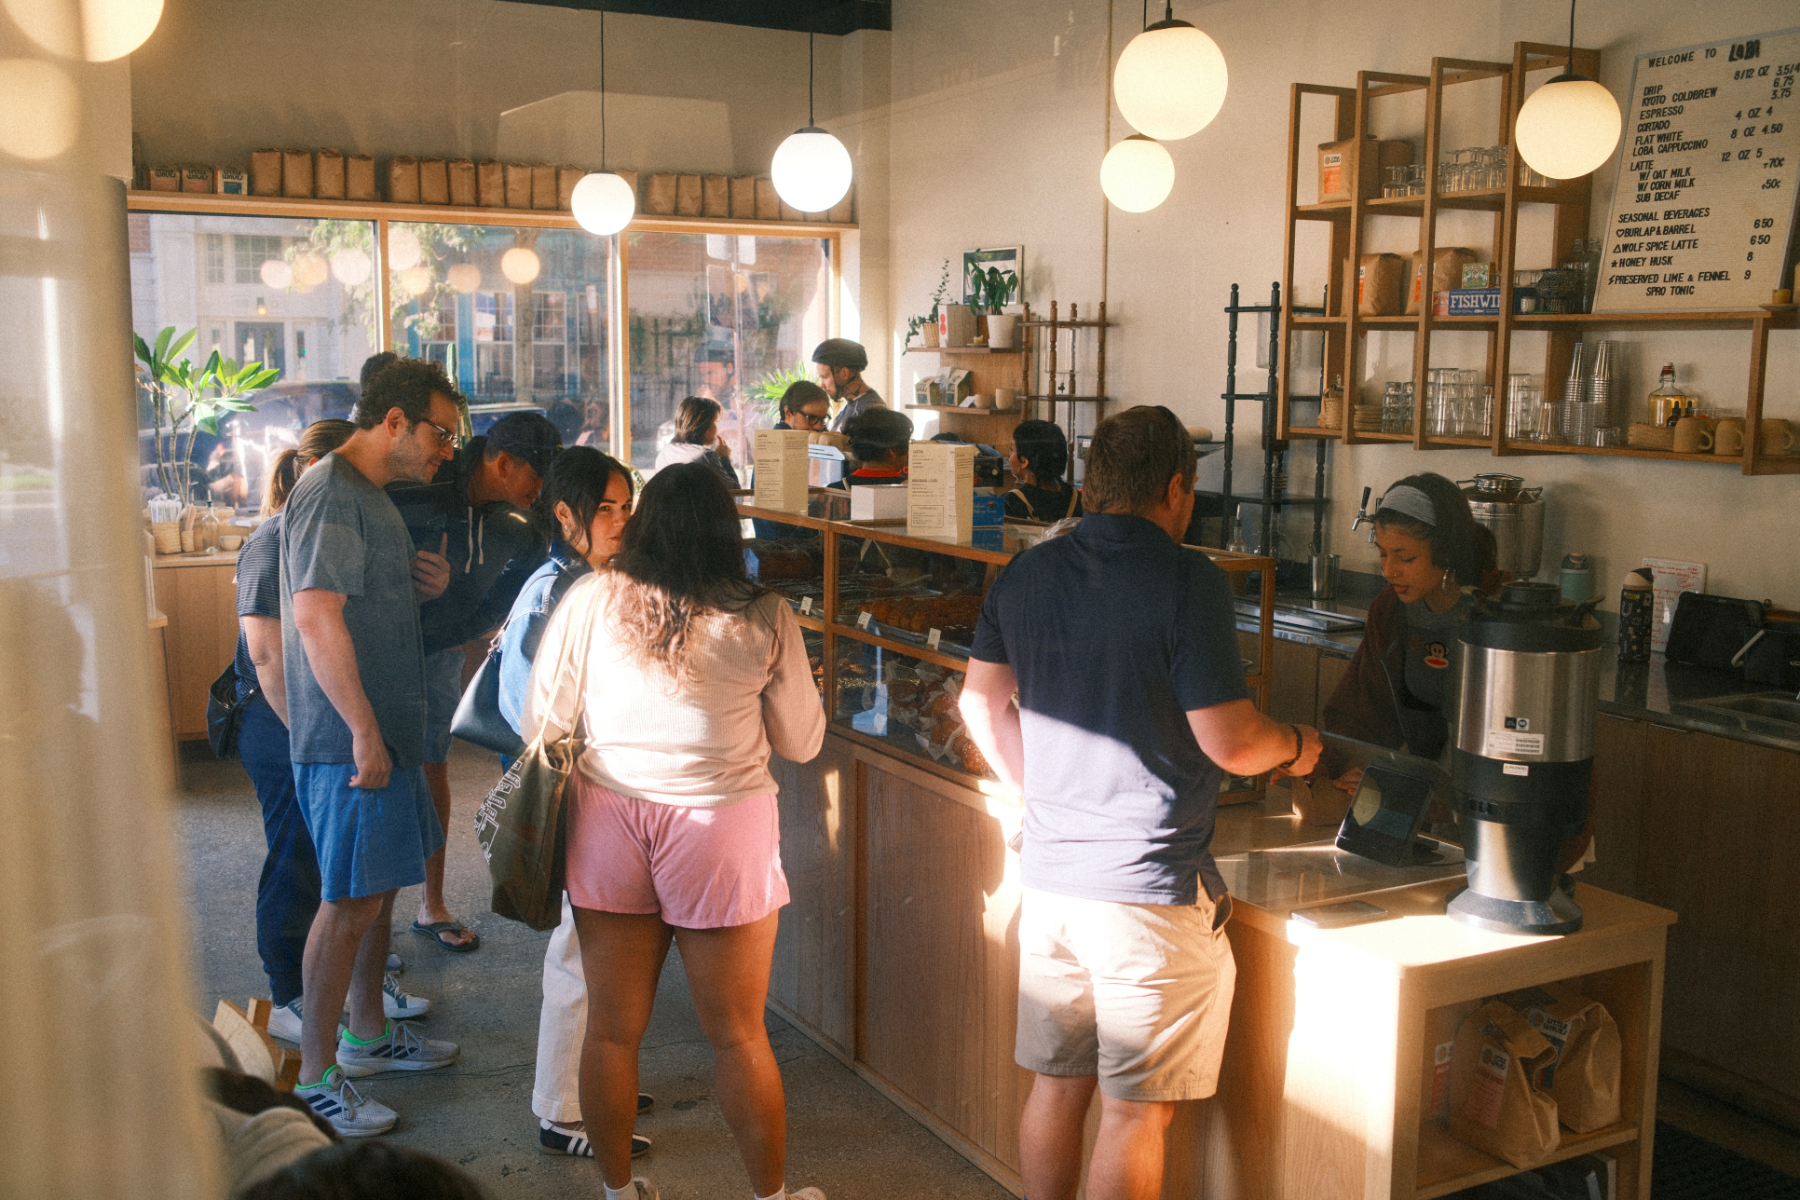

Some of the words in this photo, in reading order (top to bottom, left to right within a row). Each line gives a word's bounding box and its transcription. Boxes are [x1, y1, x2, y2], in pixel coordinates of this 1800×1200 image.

[1648, 51, 1695, 68] WELCOME
[1705, 48, 1717, 60] TO
[1643, 84, 1663, 96] DRIP
[1734, 68, 1754, 80] 8/12
[1757, 65, 1770, 77] OZ
[1641, 94, 1667, 107] KYOTO
[1672, 87, 1719, 103] COLDBREW
[1773, 75, 1795, 88] 6.75
[1639, 105, 1684, 120] ESPRESSO
[1770, 87, 1792, 100] 3.75
[1637, 120, 1671, 133] CORTADO
[1735, 110, 1742, 120] 4
[1747, 107, 1761, 119] OZ
[1766, 105, 1773, 116] 4
[1635, 134, 1655, 145] FLAT
[1656, 131, 1684, 144] WHITE
[1730, 128, 1738, 139] 8
[1743, 126, 1756, 137] OZ
[1761, 123, 1783, 135] 4.50
[1632, 147, 1654, 157] LOBA
[1657, 138, 1709, 154] CAPPUCCINO
[1630, 160, 1655, 172] LATTE
[1721, 151, 1731, 162] 12
[1738, 149, 1751, 160] OZ
[1756, 148, 1763, 159] 5
[1639, 171, 1650, 181] W/
[1652, 169, 1668, 179] OAT
[1670, 167, 1691, 178] MILK
[1638, 182, 1647, 192] W/
[1650, 180, 1671, 191] CORN
[1674, 178, 1696, 188] MILK
[1635, 193, 1651, 203] SUB
[1654, 190, 1681, 202] DECAF
[1618, 211, 1659, 223] SEASONAL
[1664, 208, 1710, 220] BEVERAGES
[1622, 241, 1644, 253] WOLF
[1645, 240, 1669, 251] SPICE
[1671, 239, 1699, 250] LATTE
[1619, 257, 1647, 267] HONEY
[1650, 256, 1673, 266] HUSK
[1747, 251, 1753, 261] 8
[1615, 274, 1659, 284] PRESERVED
[1663, 273, 1684, 283] LIME
[1688, 274, 1693, 282] &
[1698, 271, 1730, 281] FENNEL
[1744, 270, 1751, 280] 9
[1646, 286, 1666, 296] SPRO
[1670, 286, 1694, 296] TONIC
